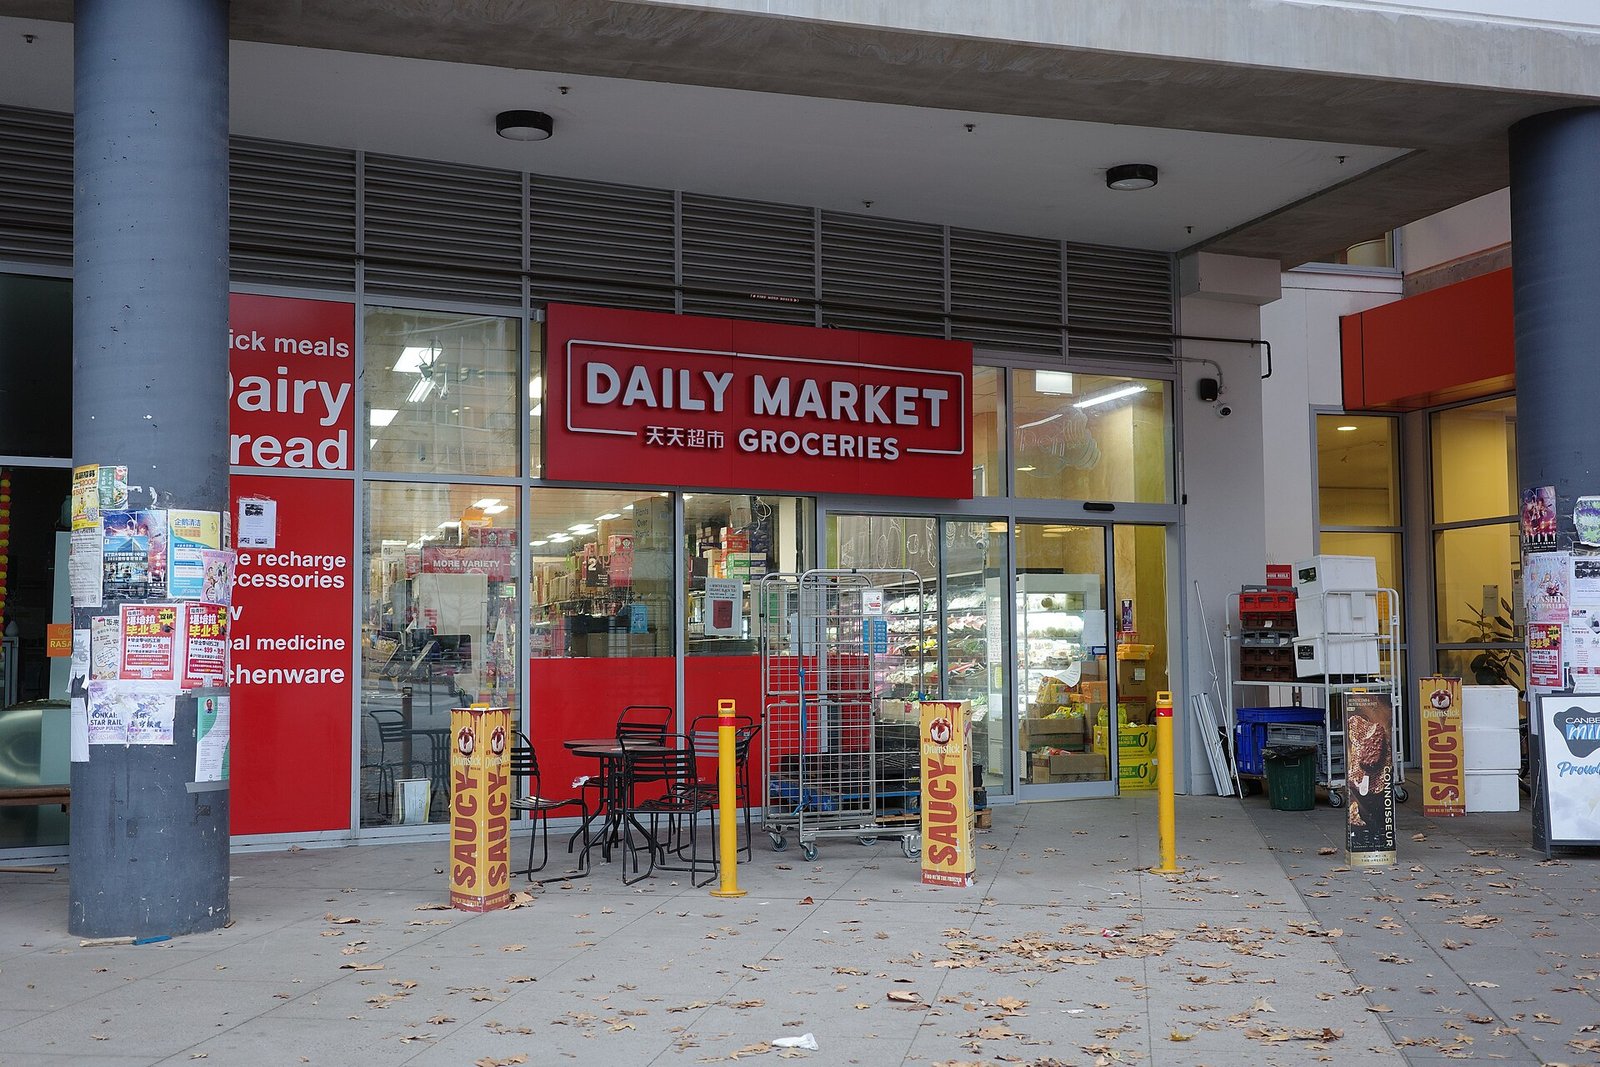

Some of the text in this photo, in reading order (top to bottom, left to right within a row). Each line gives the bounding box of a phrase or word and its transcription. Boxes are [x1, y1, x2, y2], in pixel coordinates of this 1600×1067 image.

[274, 336, 350, 358] meals
[229, 366, 352, 427] airy
[587, 362, 949, 427] DAILY MARKET
[230, 429, 348, 470] read
[646, 425, 725, 449] 天天超市
[738, 428, 899, 461] GROCERIES
[257, 551, 346, 571] recharge
[433, 560, 500, 568] MORE VARIETY
[588, 558, 597, 571] 2
[126, 624, 161, 635] 毕业季
[229, 635, 250, 650] al
[256, 635, 346, 650] medicine
[1423, 709, 1459, 719] Drumstick
[923, 743, 961, 756] Drumstick
[1427, 720, 1460, 801] SAUCY
[928, 757, 959, 866] SAUCY
[1383, 765, 1393, 847] CONNOISSEUR
[454, 770, 478, 889] SAUCY
[488, 771, 508, 888] SAUCY
